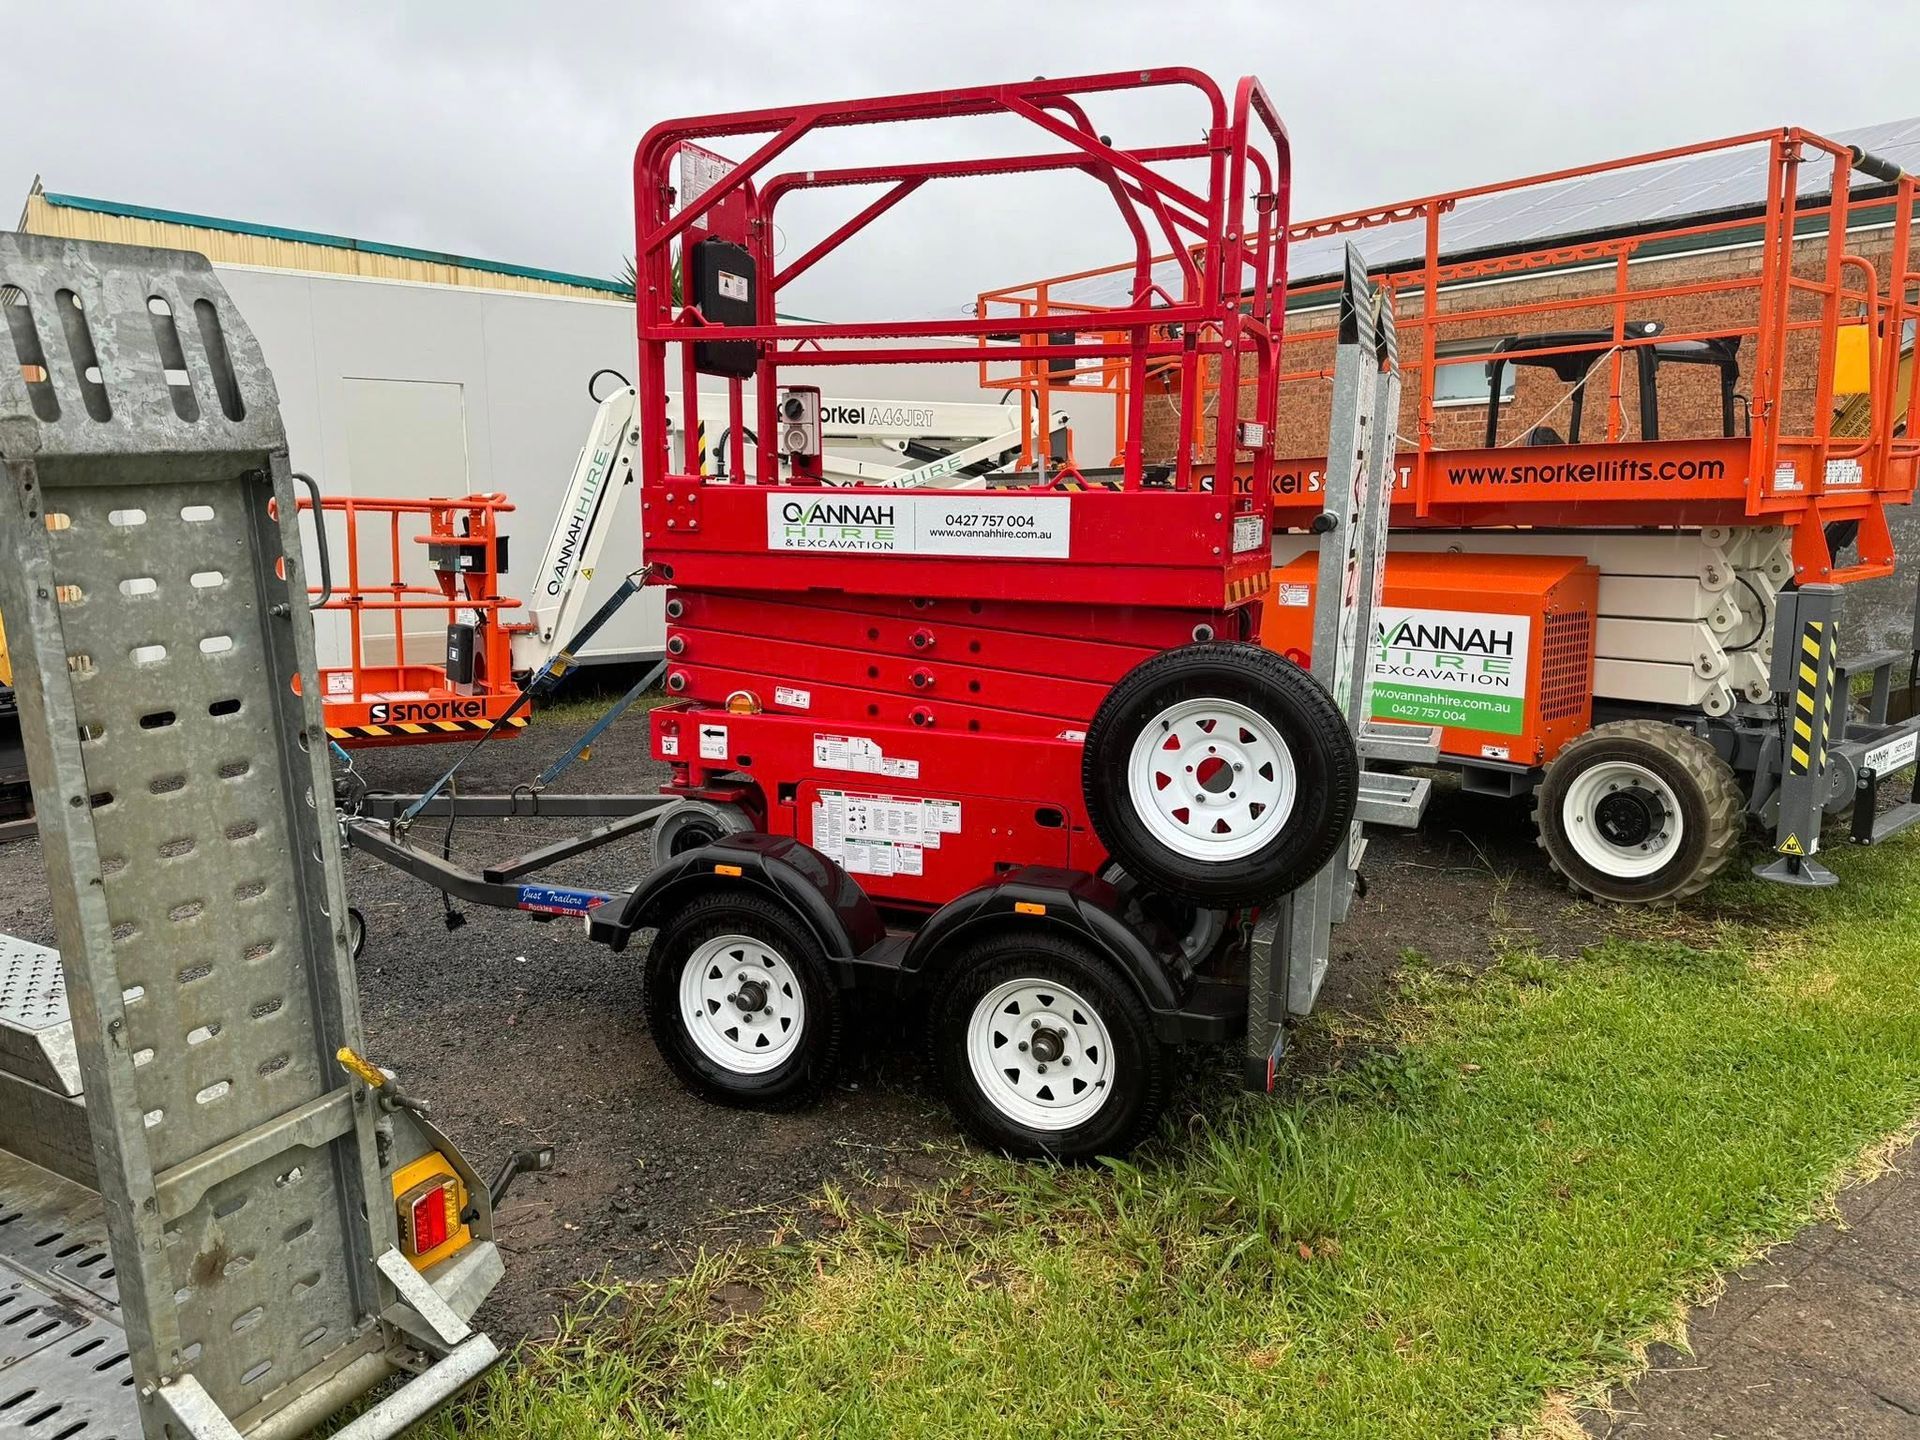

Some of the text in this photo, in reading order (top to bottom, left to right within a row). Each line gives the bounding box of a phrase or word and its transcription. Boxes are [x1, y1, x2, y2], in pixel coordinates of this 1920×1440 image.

[869, 407, 934, 427] A46JRT
[576, 449, 607, 514] HIRE
[900, 456, 962, 488] HIRE
[1448, 459, 1725, 485] www.snorkellifts.com
[945, 514, 1035, 527] 0427 757 004
[786, 527, 895, 540] HIRE
[929, 528, 1052, 540] www.ovannahhire.com.au
[785, 539, 894, 550] & EXCAVATION
[1375, 663, 1510, 687] EXCAVATION
[392, 698, 487, 721] snorkel
[1391, 703, 1467, 722] 0427 757 004
[523, 888, 583, 905] Just Trailers
